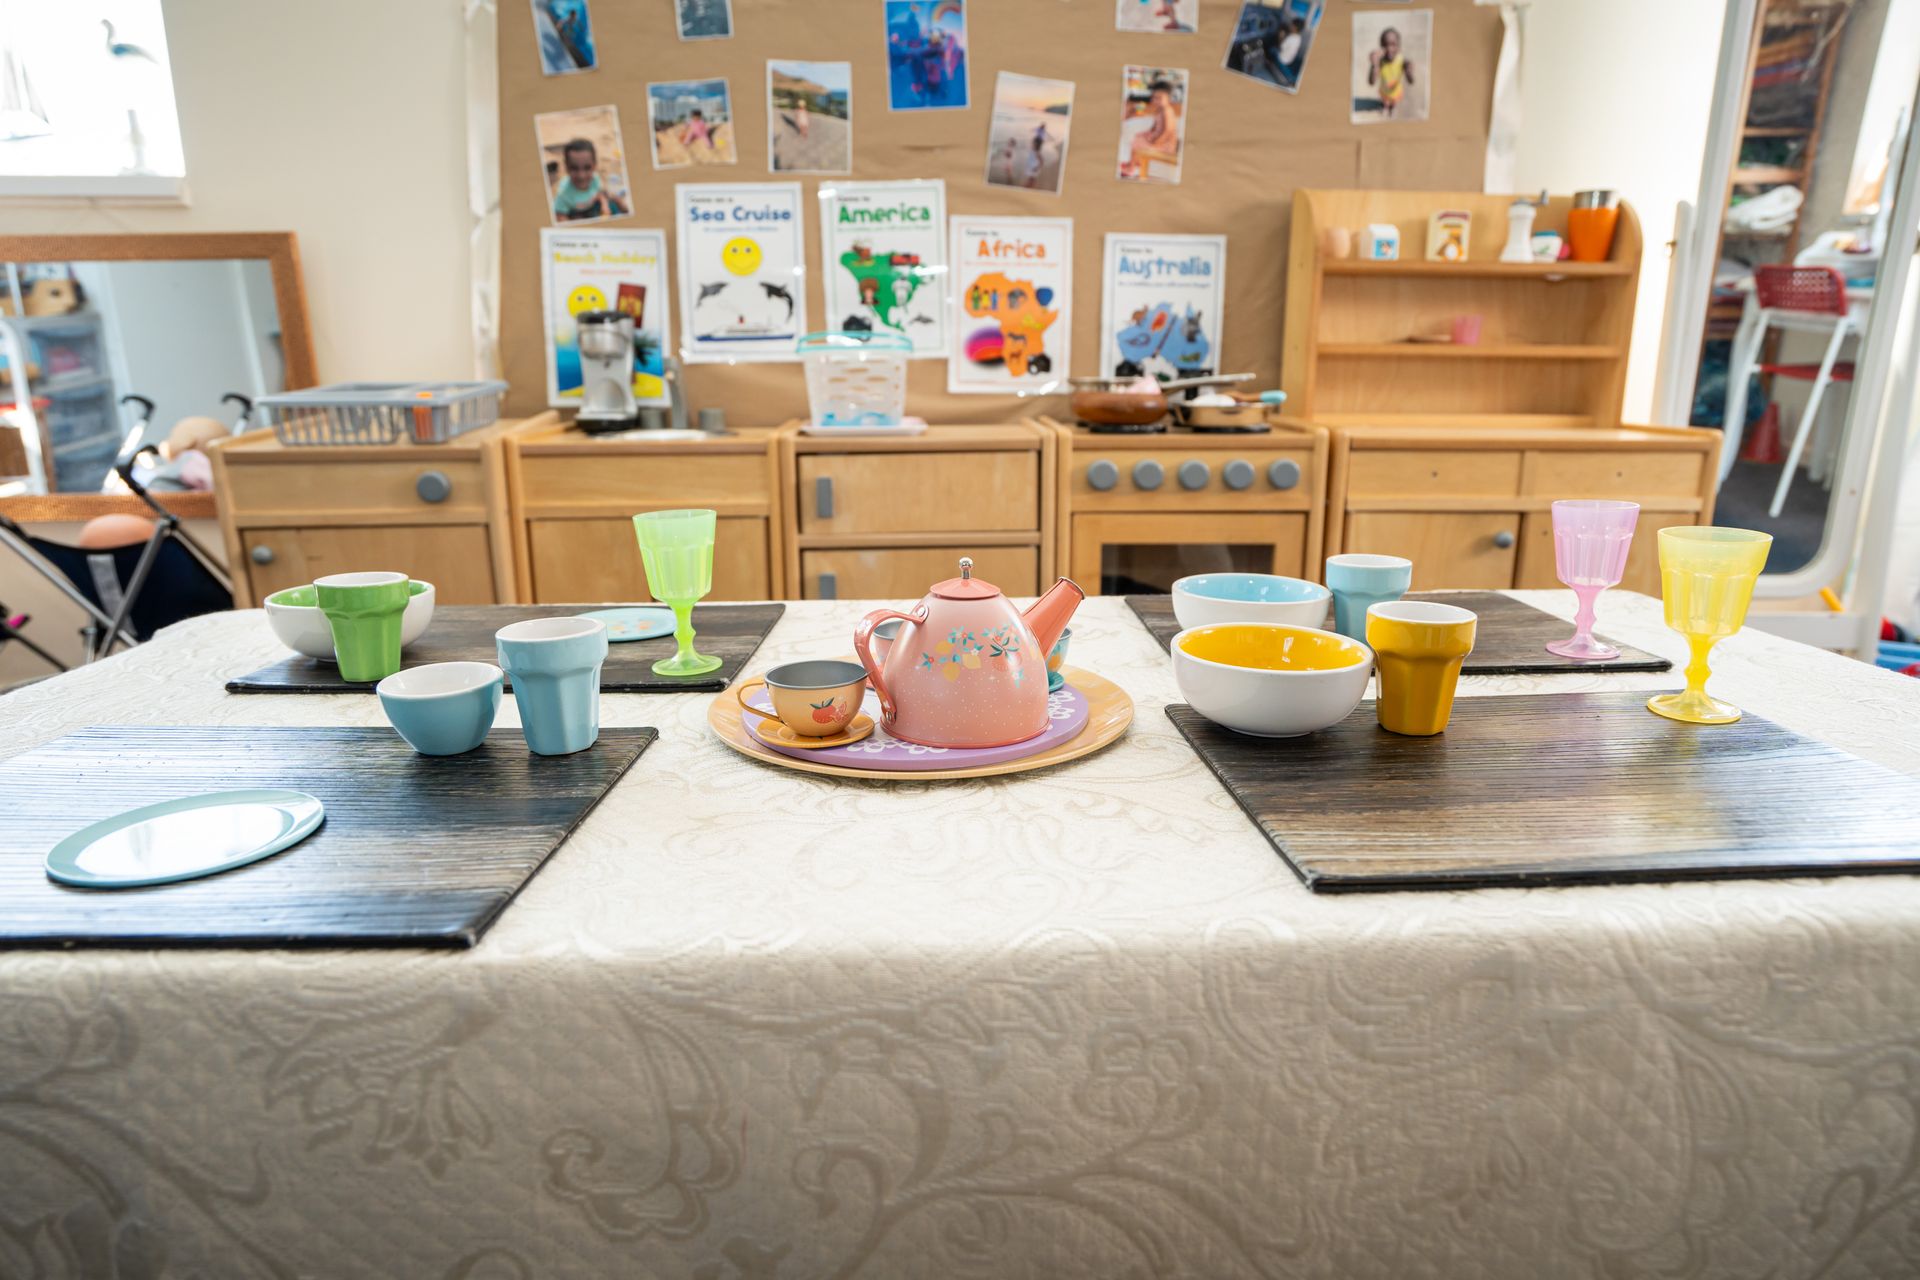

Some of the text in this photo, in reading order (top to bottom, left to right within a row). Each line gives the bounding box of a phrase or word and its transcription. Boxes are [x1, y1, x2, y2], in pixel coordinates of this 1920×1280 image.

[690, 205, 791, 222] Sea Cruise
[839, 202, 930, 223] America
[978, 239, 1046, 259] Africa
[1120, 256, 1212, 280] Australia
